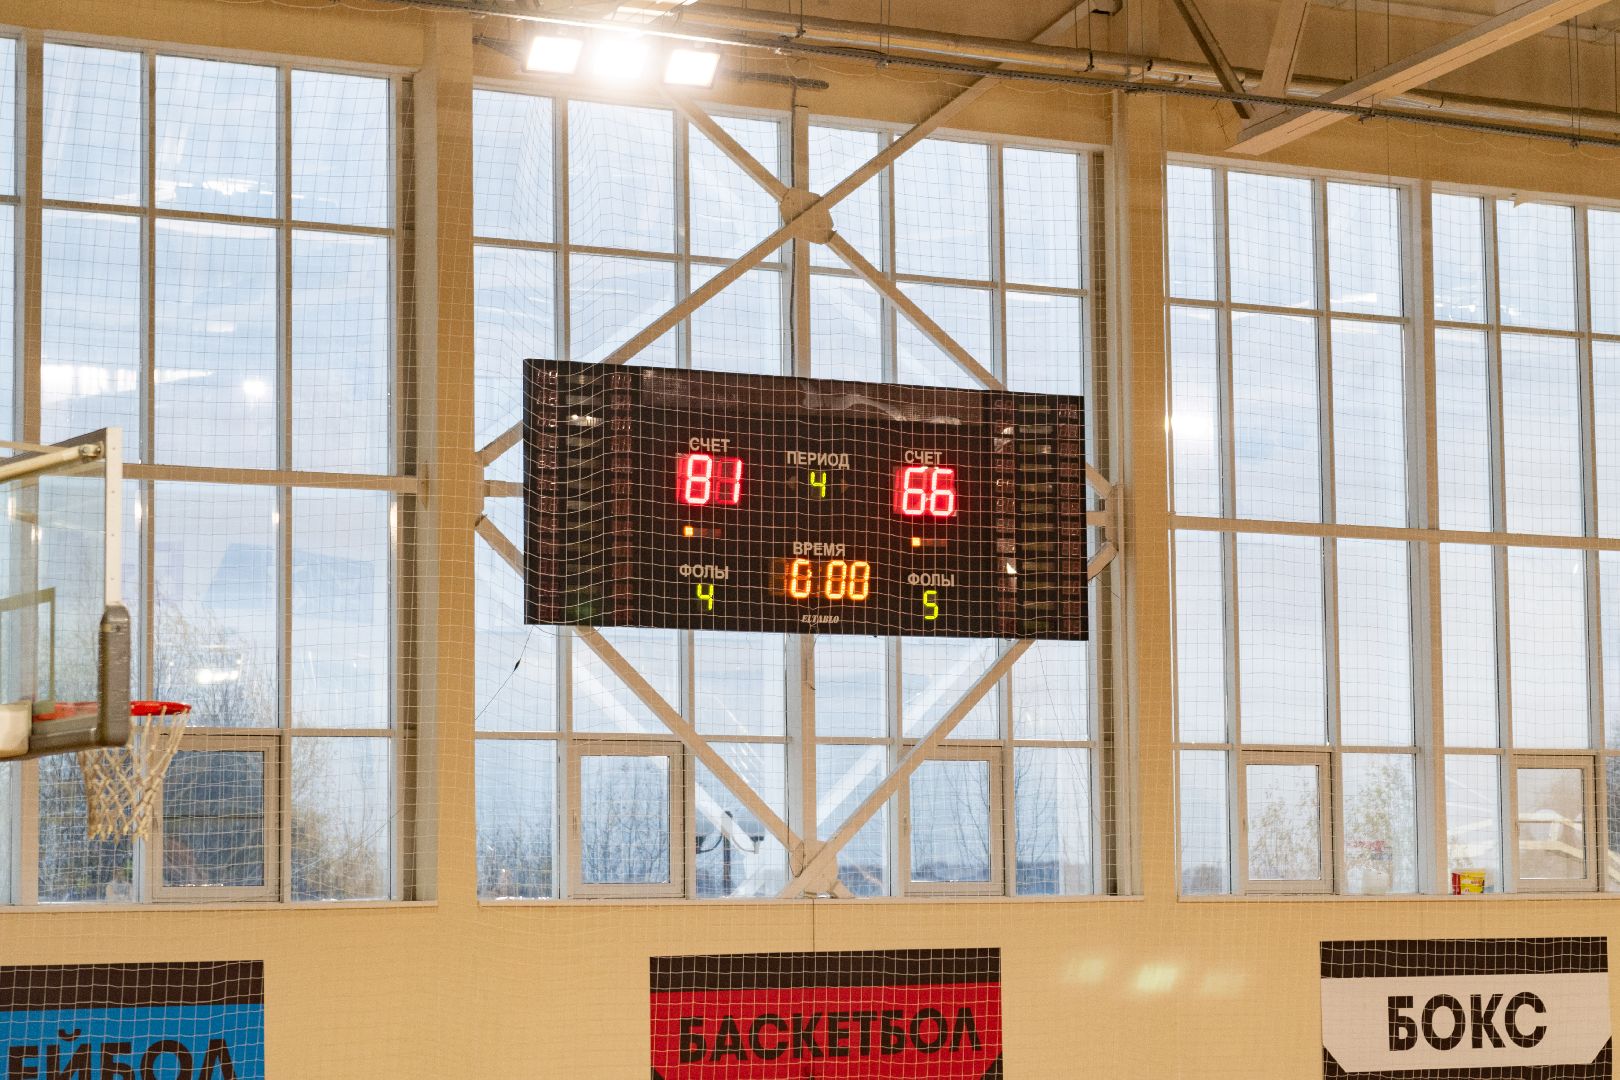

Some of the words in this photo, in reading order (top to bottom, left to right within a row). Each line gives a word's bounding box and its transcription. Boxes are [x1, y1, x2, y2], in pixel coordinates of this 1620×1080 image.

[689, 437, 730, 452] СЧЕТ
[904, 450, 942, 465] СЧЕТ
[787, 451, 850, 470] ПЕРИОД
[685, 454, 742, 504] 81
[810, 471, 827, 498] 4
[902, 466, 955, 516] 66
[792, 541, 846, 557] ВРЕМЯ
[679, 564, 729, 579] ФОЛЫ
[907, 572, 955, 587] ФОЛЫ
[697, 583, 714, 610] 4
[923, 590, 939, 620] 5
[1388, 991, 1548, 1051] БОКС
[679, 1007, 983, 1063] БАСКЕТБОЛ
